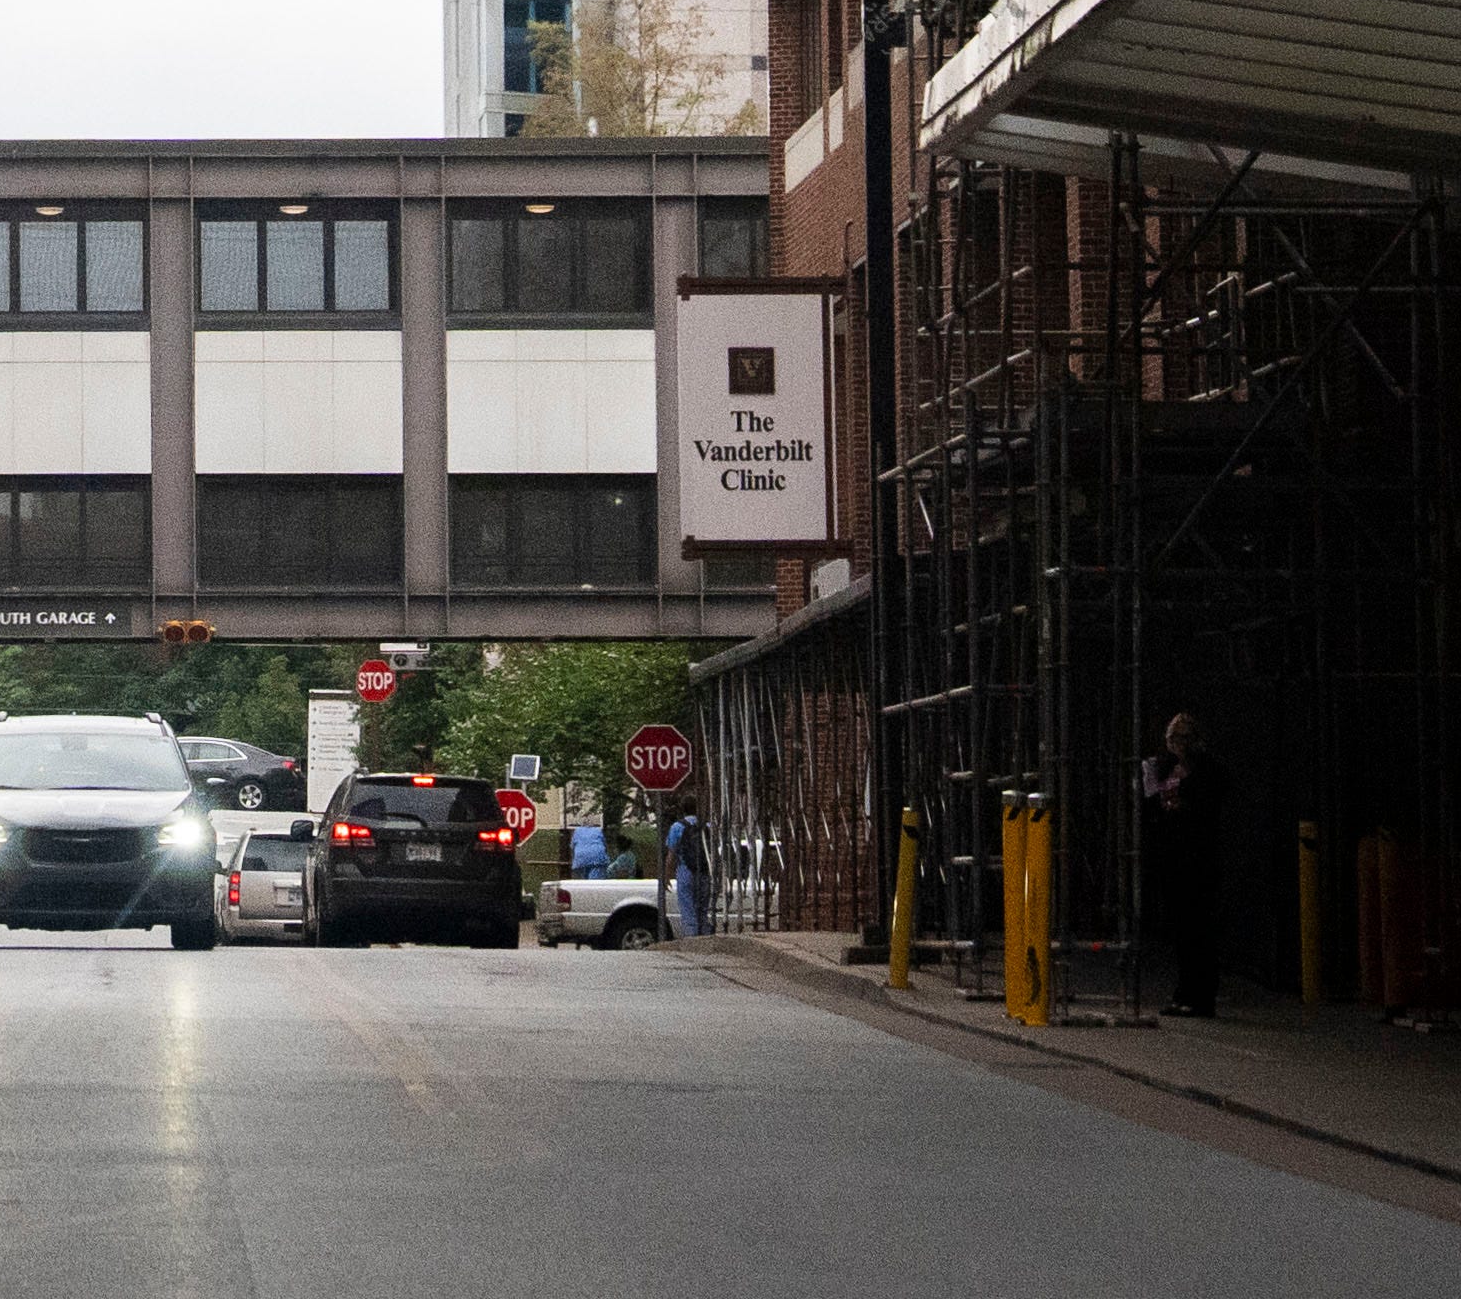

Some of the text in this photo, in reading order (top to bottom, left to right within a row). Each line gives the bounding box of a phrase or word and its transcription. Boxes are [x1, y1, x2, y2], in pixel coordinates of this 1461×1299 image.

[730, 411, 775, 432] The
[694, 440, 814, 462] Vanderbilt
[720, 468, 787, 492] Clinic
[36, 611, 95, 626] GARAGE
[358, 671, 394, 691] STOP
[631, 746, 687, 771] STOP
[501, 806, 534, 828] OP
